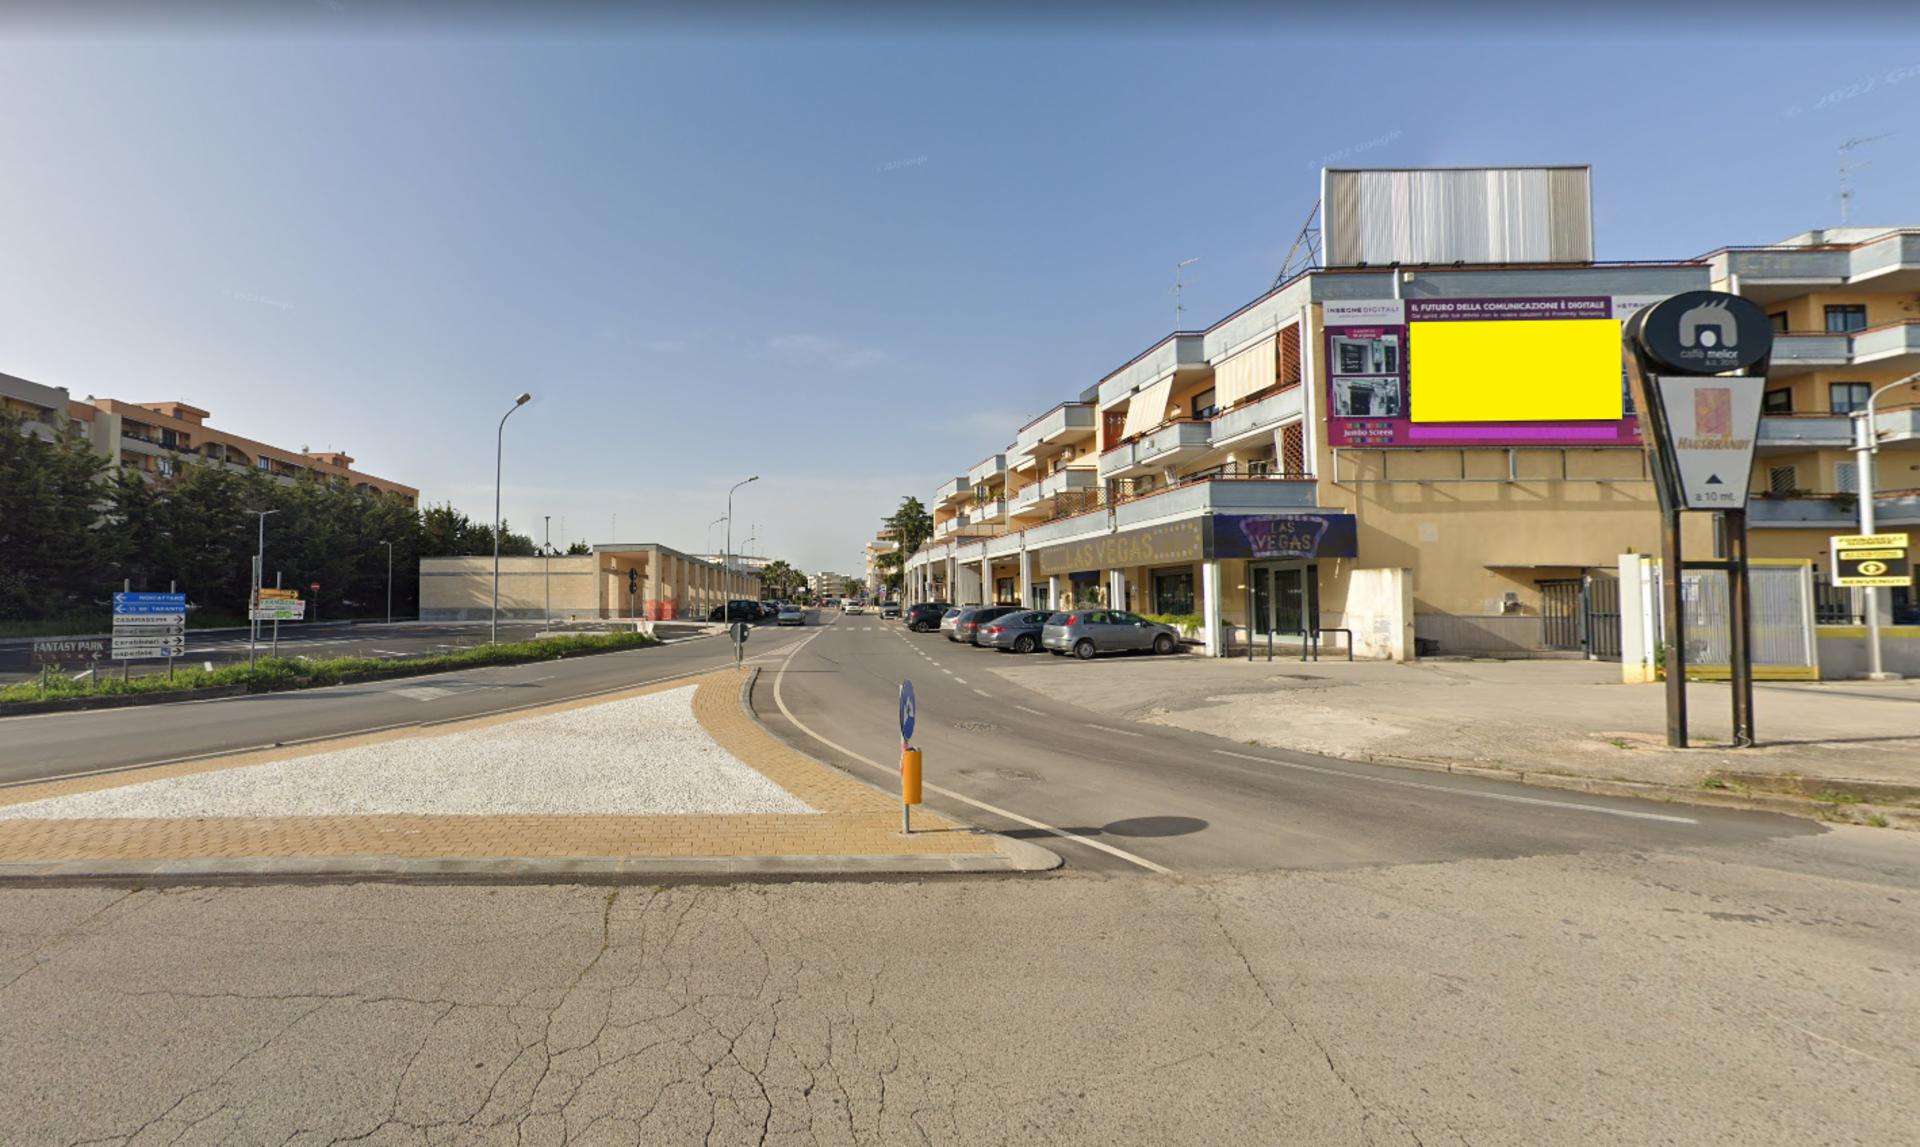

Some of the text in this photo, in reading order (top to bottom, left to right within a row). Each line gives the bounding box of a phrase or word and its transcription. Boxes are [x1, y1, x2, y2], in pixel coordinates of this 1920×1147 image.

[1411, 304, 1419, 312] IL
[1456, 303, 1481, 311] DELLA
[1483, 302, 1558, 310] COMUNICAZIONE
[1561, 300, 1566, 309] È
[1568, 301, 1605, 309] DIGITALE
[1707, 348, 1738, 359] melior
[1344, 429, 1367, 437] Jumbo
[1704, 491, 1717, 501] 10
[1271, 521, 1296, 534] LAS
[1255, 534, 1312, 551] VEGAS
[1066, 532, 1153, 567] LAS VEGAS
[33, 640, 104, 652] FANTASY PARK
